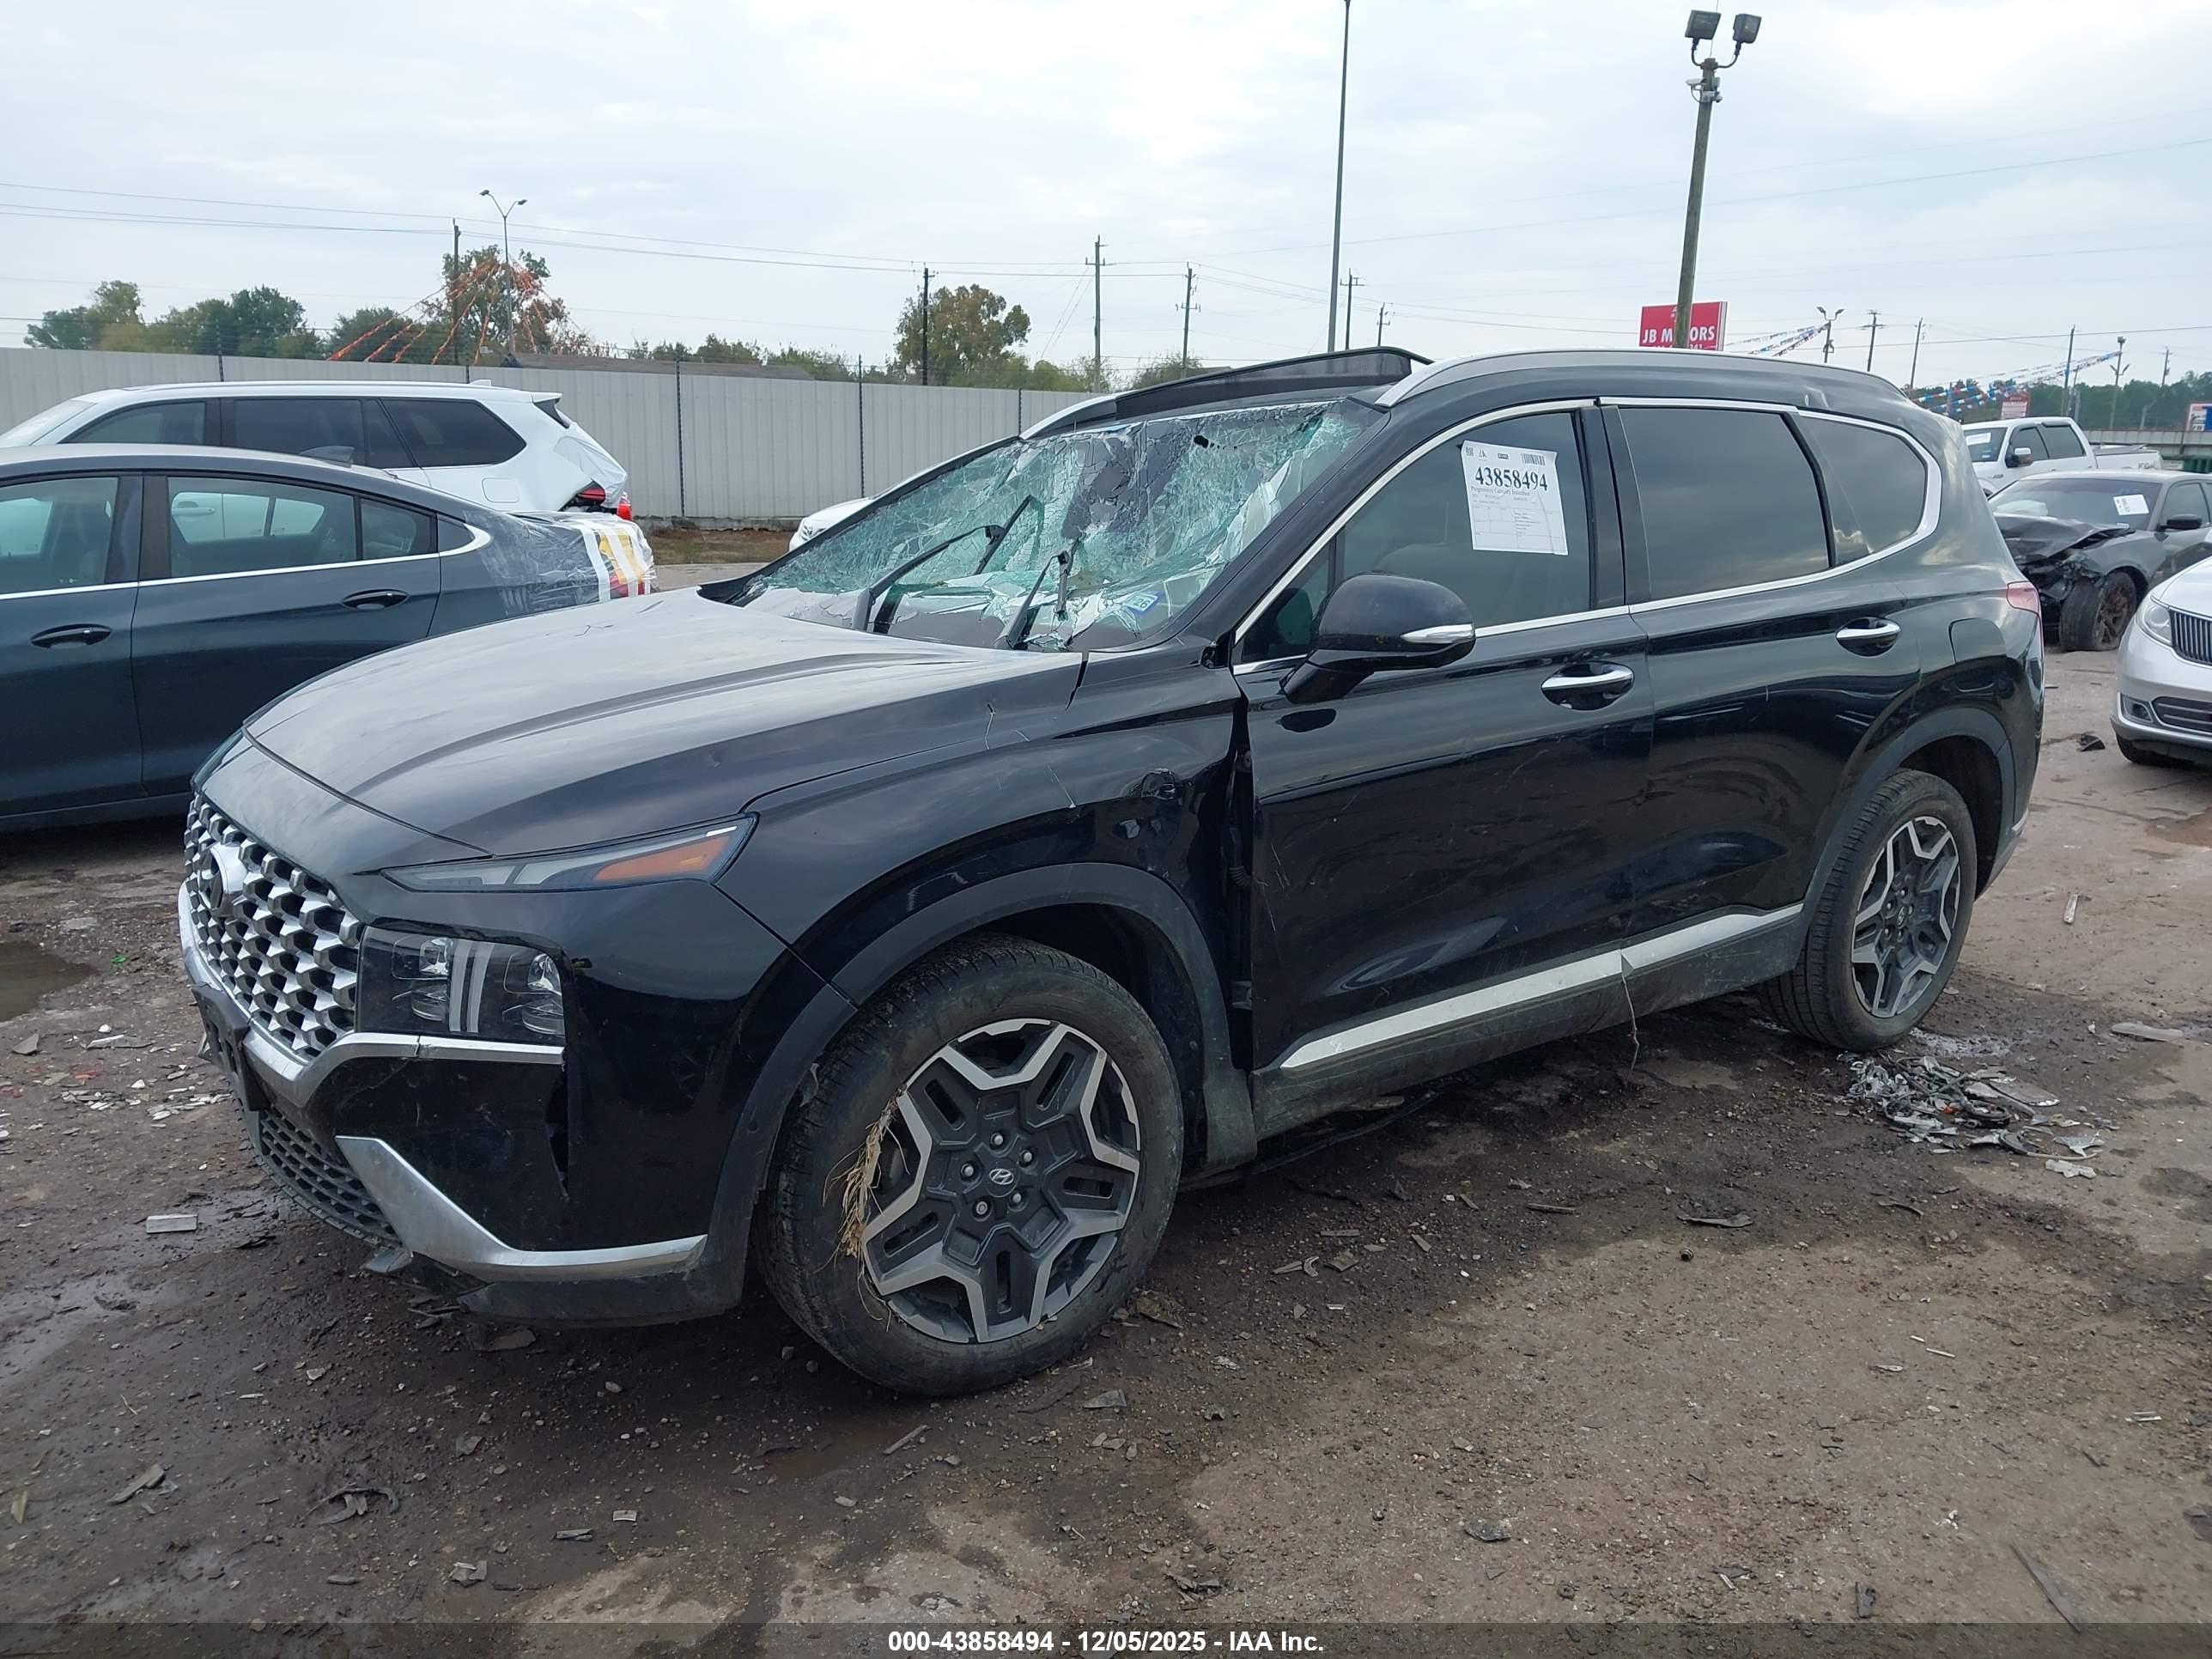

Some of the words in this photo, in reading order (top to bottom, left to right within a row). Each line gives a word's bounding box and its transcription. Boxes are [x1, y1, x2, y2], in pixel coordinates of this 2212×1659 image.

[1643, 329, 1657, 343] JB
[1661, 326, 1716, 343] MORS
[1475, 466, 1548, 491] 43858494
[1133, 599, 1151, 609] 26
